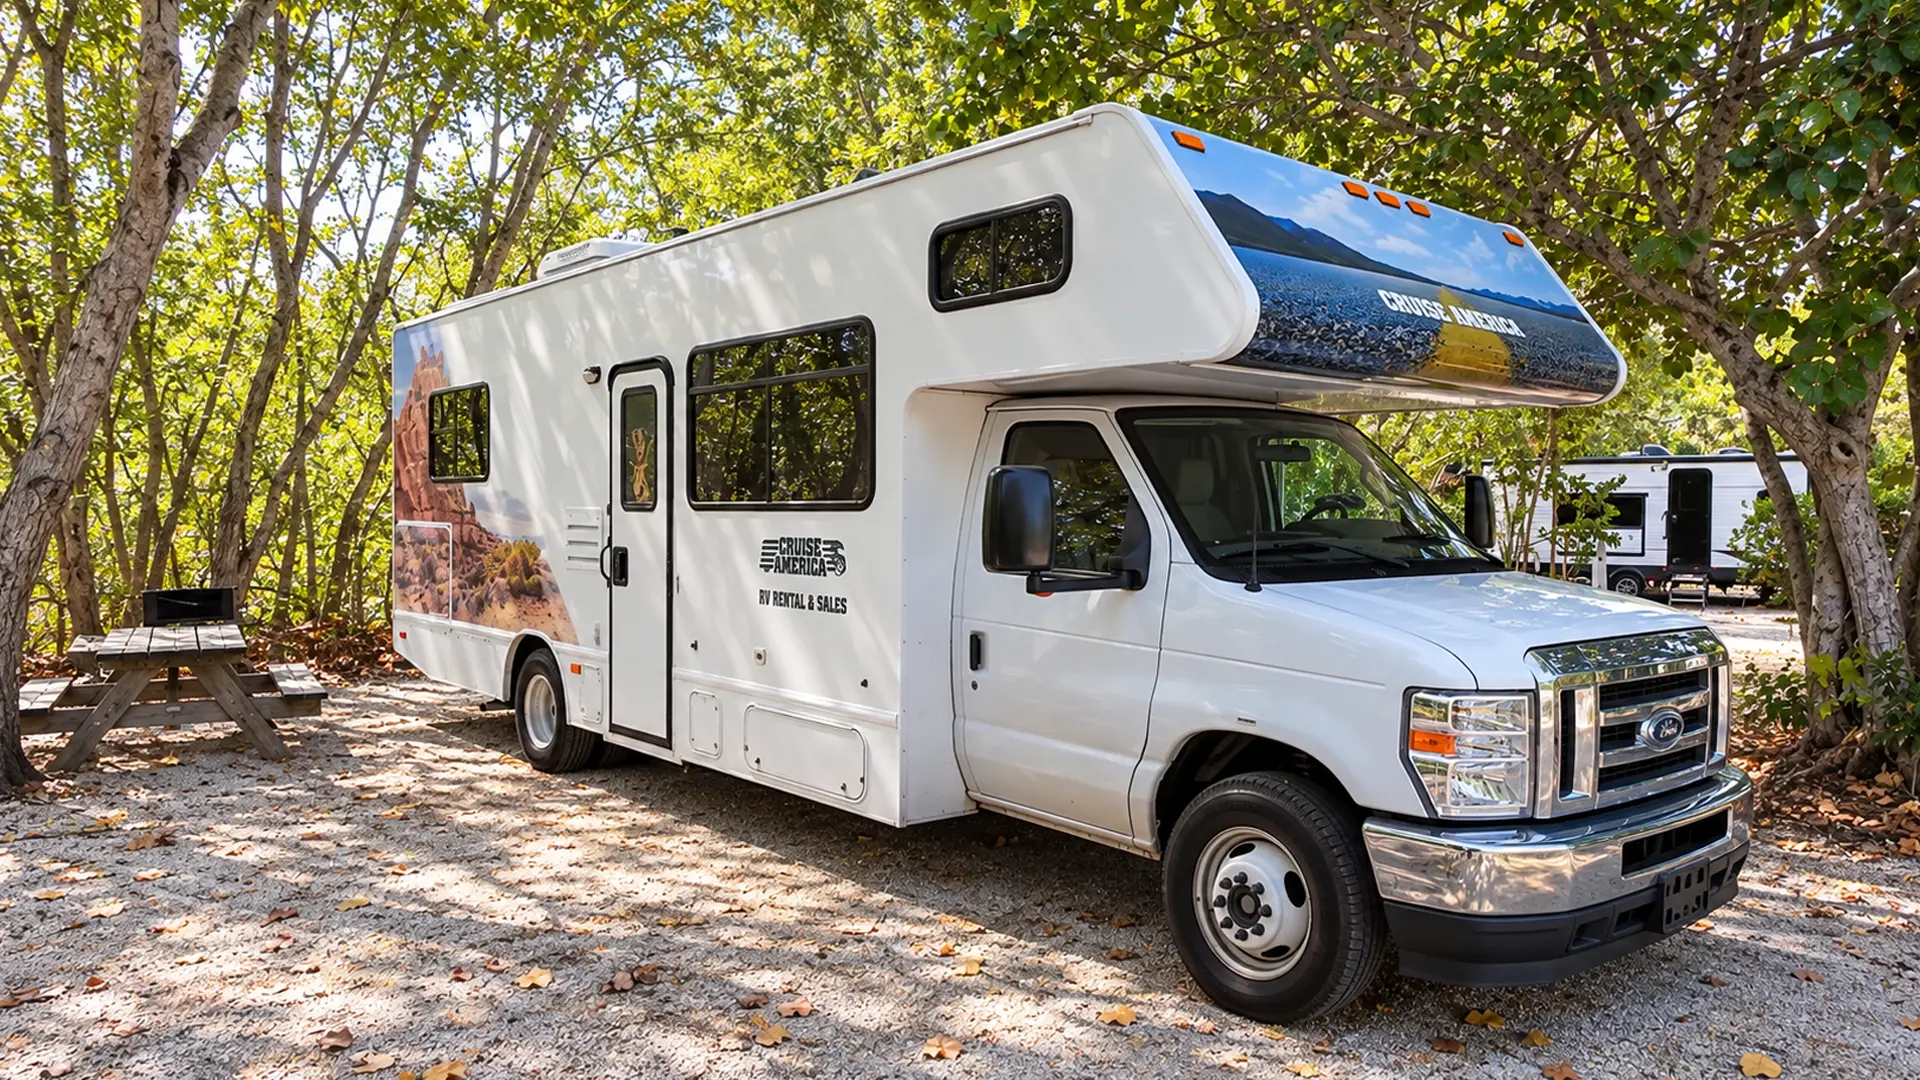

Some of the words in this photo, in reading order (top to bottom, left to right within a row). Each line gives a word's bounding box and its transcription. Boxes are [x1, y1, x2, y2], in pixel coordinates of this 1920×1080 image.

[1377, 289, 1452, 322] CRUISE
[1448, 305, 1526, 338] AMERICA
[779, 537, 822, 556] CRUISE
[774, 556, 827, 577] AMERICA
[759, 589, 770, 605] RV
[773, 591, 805, 609] RENTAL
[808, 595, 814, 610] &
[817, 595, 847, 614] SALES
